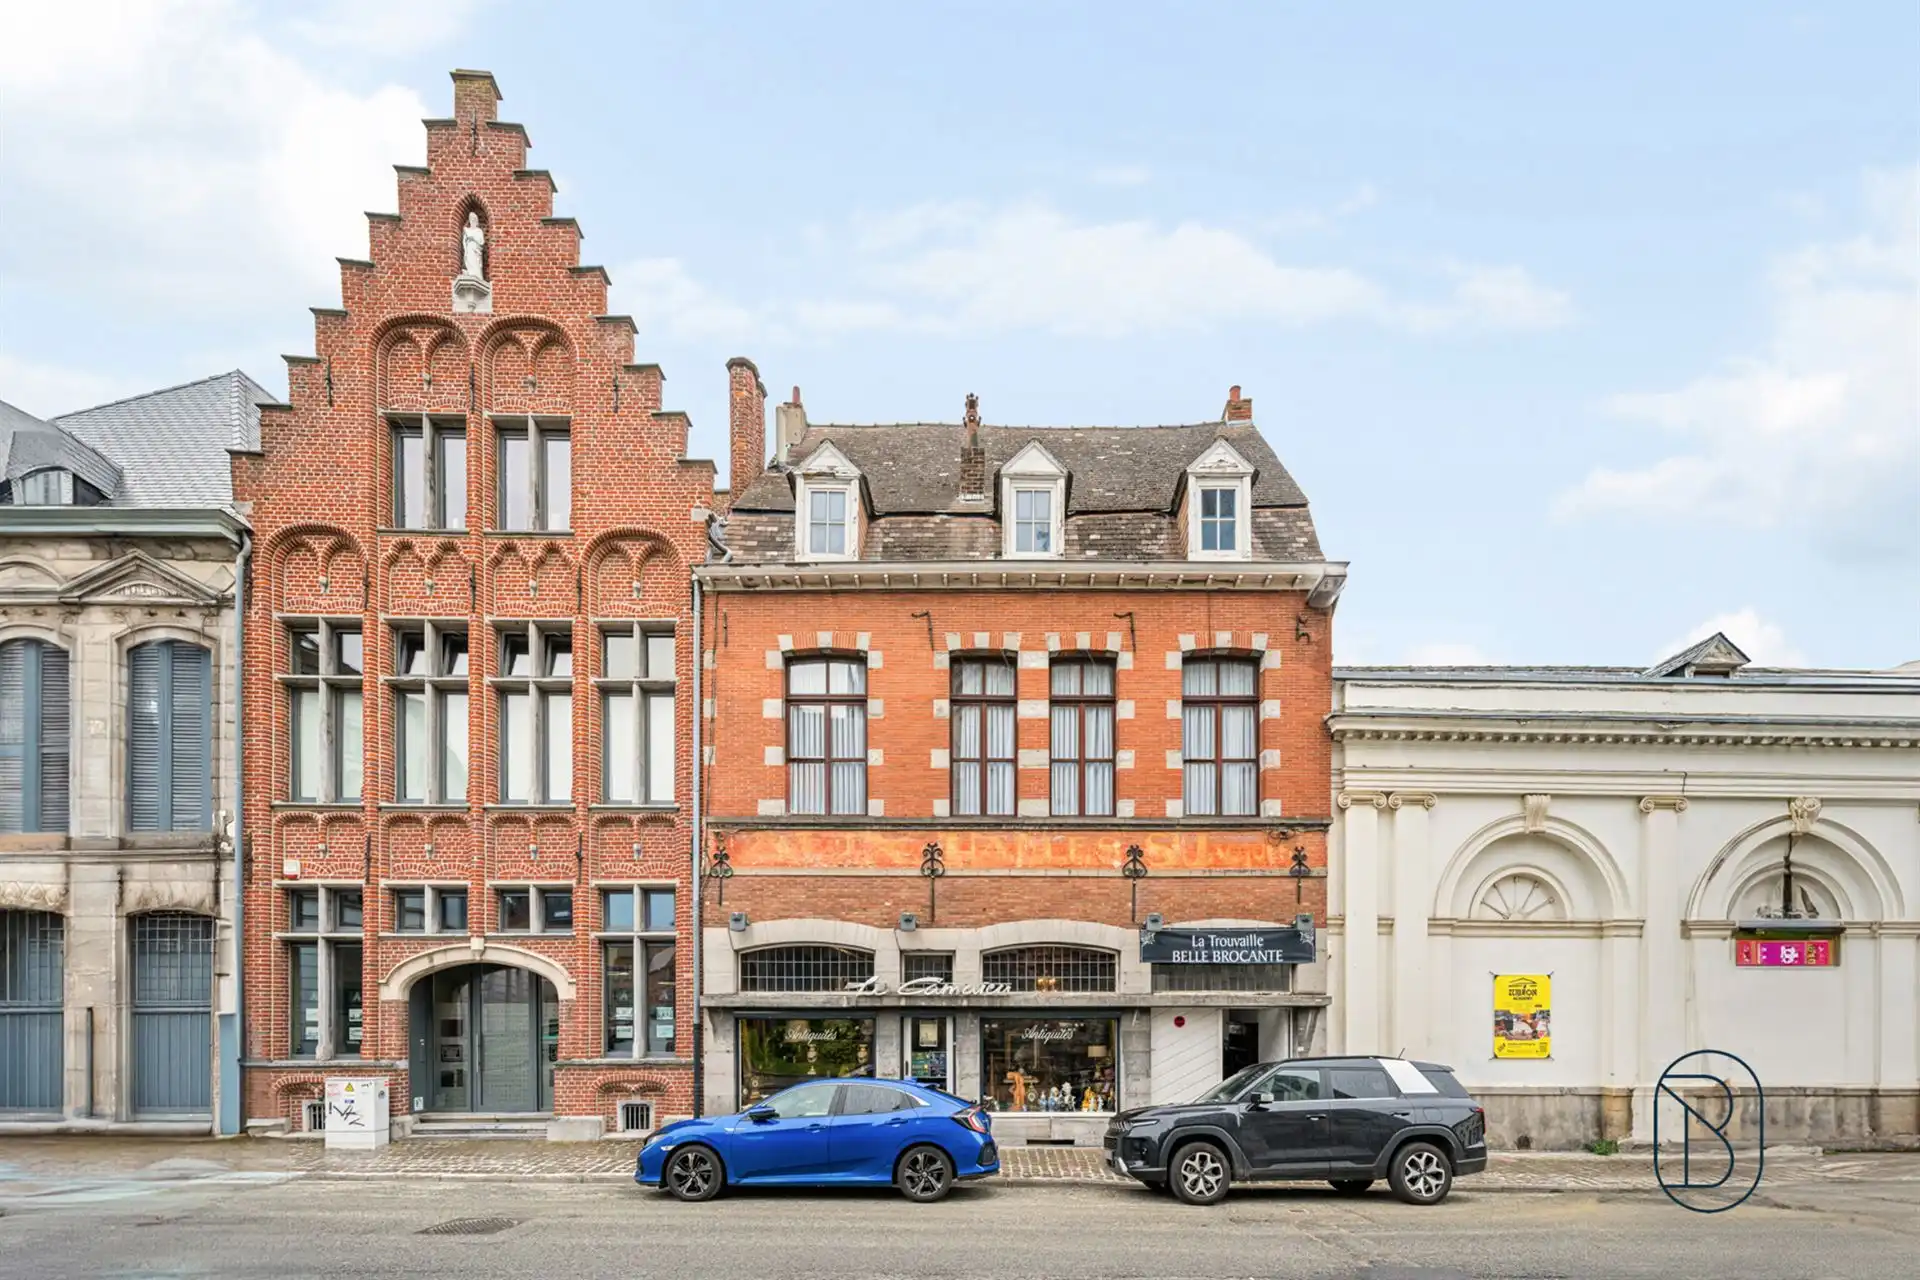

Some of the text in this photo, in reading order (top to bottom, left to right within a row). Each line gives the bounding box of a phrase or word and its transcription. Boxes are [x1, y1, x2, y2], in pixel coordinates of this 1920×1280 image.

[1191, 934, 1264, 948] La Trouvaille
[1172, 949, 1284, 963] BELLE BROCANTE
[784, 1024, 838, 1045] Antiquités
[1021, 1024, 1074, 1044] Antiquités
